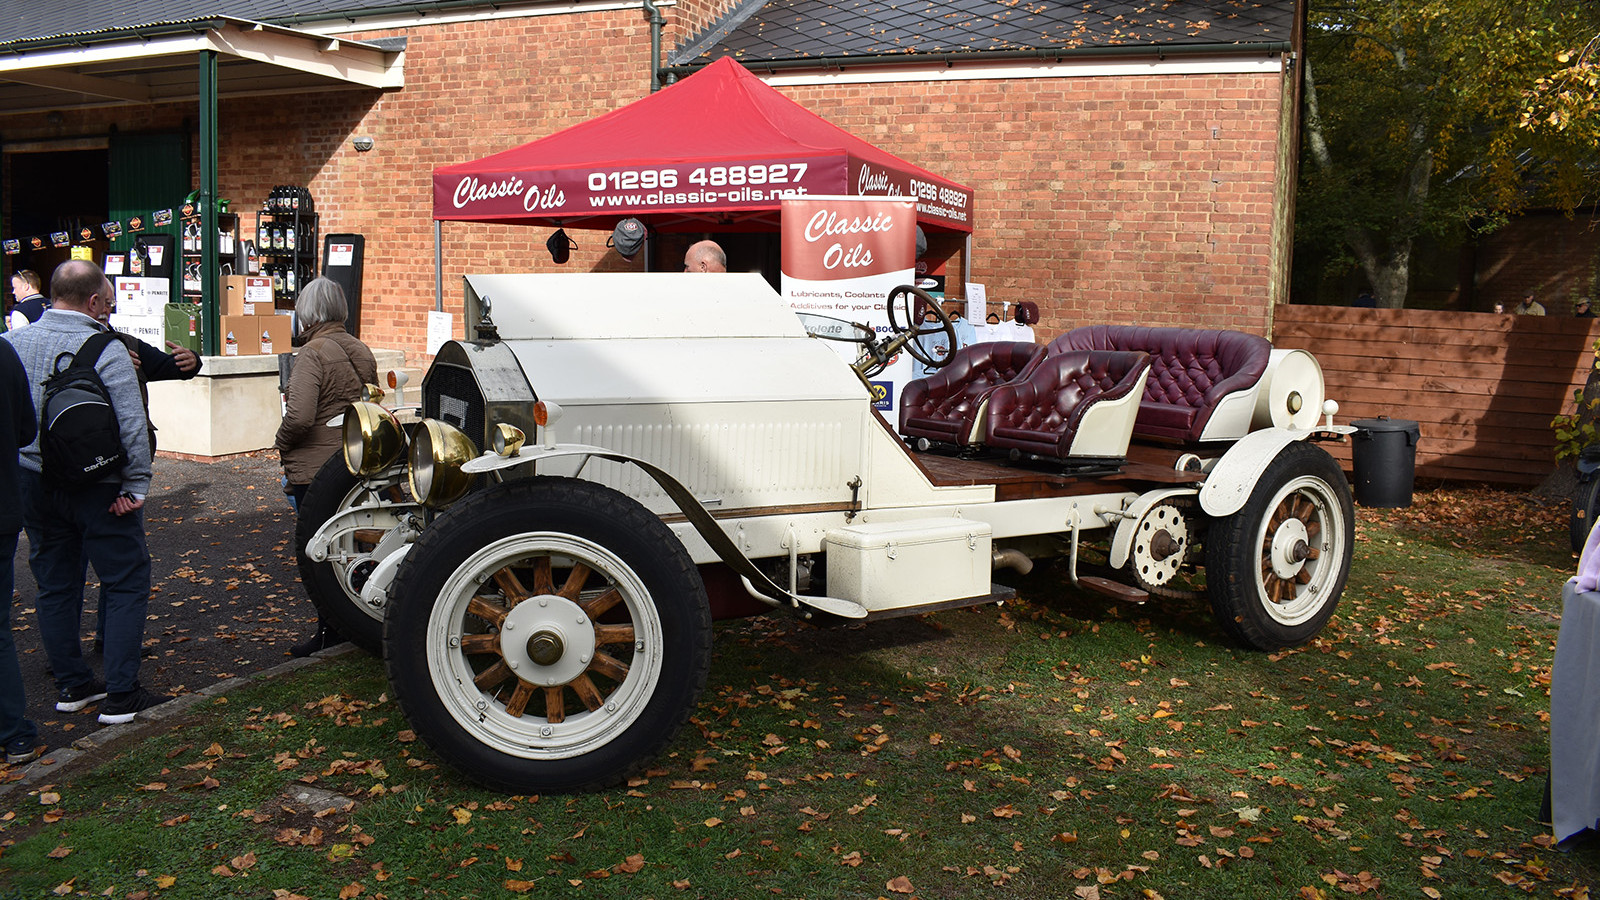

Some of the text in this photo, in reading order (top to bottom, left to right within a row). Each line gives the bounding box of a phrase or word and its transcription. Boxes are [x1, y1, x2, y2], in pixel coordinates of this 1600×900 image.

[588, 162, 808, 192] 01296 488927
[858, 163, 889, 197] Classic
[453, 176, 524, 209] Classic
[523, 184, 567, 212] Oils
[589, 186, 808, 207] www.classic-oils.net
[910, 178, 968, 209] 01296 488927
[804, 209, 894, 243] Classic
[823, 242, 875, 270] Oils
[790, 302, 833, 310] Additives
[851, 304, 872, 312] your
[791, 290, 843, 300] Lubricants,
[844, 291, 886, 299] Coolants
[138, 327, 159, 335] PENRITE
[804, 325, 842, 334] kolene
